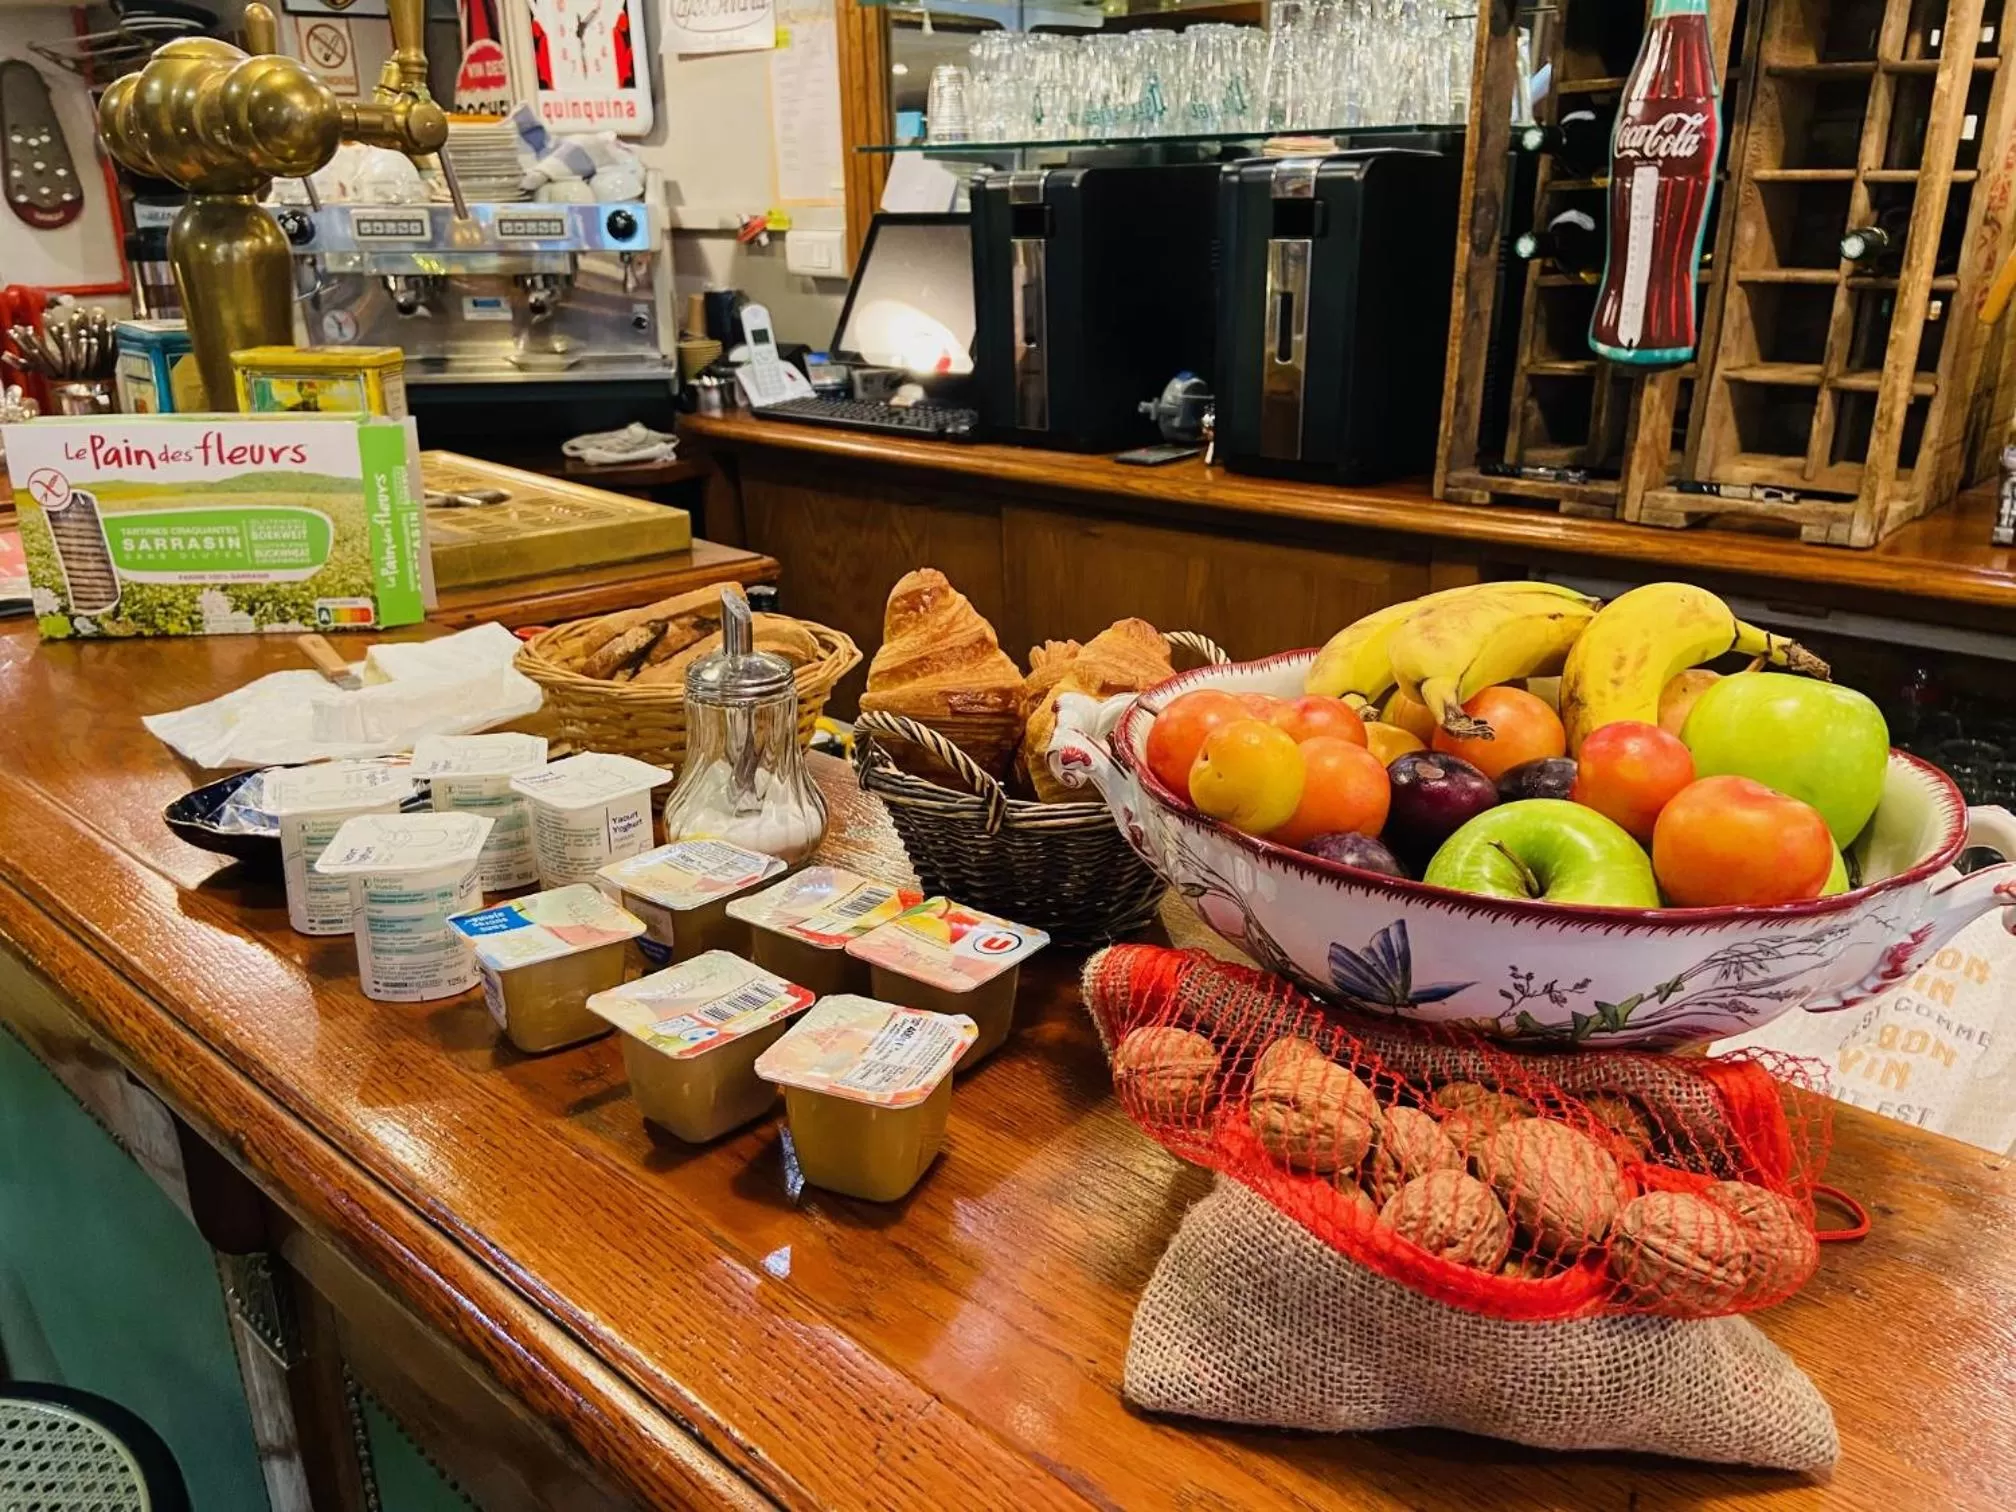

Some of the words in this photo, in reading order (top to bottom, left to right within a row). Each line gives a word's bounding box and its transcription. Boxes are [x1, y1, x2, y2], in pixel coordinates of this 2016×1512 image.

[542, 98, 637, 125] quinquina
[64, 442, 88, 461] Le
[89, 434, 156, 470] Pain
[157, 444, 193, 463] des
[194, 431, 307, 467] fleurs
[372, 473, 393, 528] fleurs
[121, 535, 242, 552] SARRASIN
[611, 818, 643, 834] Yoghurt
[1935, 948, 1991, 985] ON
[1894, 996, 1994, 1051] COMME
[1878, 1022, 1957, 1067] BON
[1838, 1046, 1912, 1091] VIN
